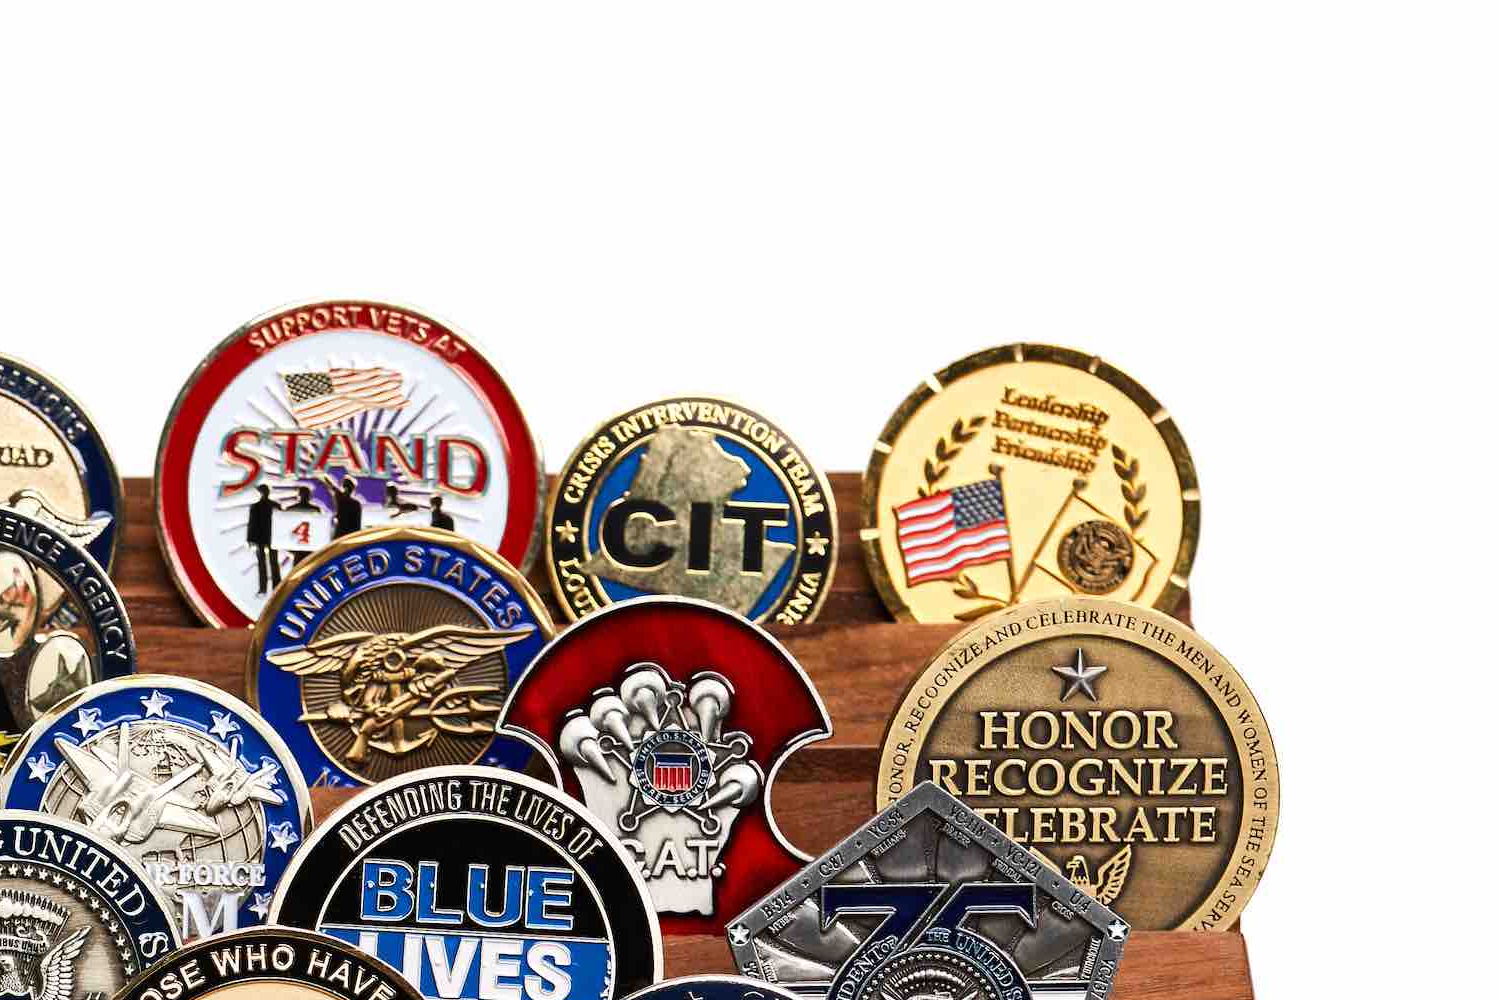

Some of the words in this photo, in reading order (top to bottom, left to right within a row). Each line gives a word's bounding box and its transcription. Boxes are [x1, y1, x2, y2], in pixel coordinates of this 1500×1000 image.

[248, 306, 363, 353] SUPPORT
[369, 306, 430, 343] VETS
[433, 332, 468, 361] AT
[1001, 386, 1109, 432] Leadership
[991, 410, 1108, 457] Partnership
[218, 426, 492, 500] STAND
[564, 435, 616, 504] CRISIS
[611, 401, 782, 454] INTERVENTION
[779, 446, 825, 517] TEAM
[991, 436, 1097, 476] Friendship
[602, 498, 791, 576] CIT
[67, 562, 128, 664] AGENCY
[279, 548, 392, 640] UNITED
[404, 545, 523, 629] STATES
[985, 622, 1023, 650] AND
[1026, 610, 1137, 630] CELEBRATE
[1141, 621, 1175, 646] THE
[1176, 640, 1214, 675] MEN
[904, 642, 984, 732] RECOGNIZE
[1209, 669, 1241, 708] AND
[979, 710, 1178, 750] HONOR
[1236, 708, 1267, 781] WOMEN
[929, 757, 1229, 797] RECOGNIZE
[1254, 787, 1267, 811] OF
[338, 779, 461, 853] DEFENDING
[469, 780, 509, 814] THE
[514, 790, 576, 840] LIVES
[569, 828, 604, 861] OF
[976, 806, 1217, 843] ELEBRATE
[1245, 816, 1266, 852] THE
[13, 826, 148, 918] UNITED
[178, 863, 267, 887] FORCE
[359, 858, 575, 931] BLUE
[1194, 890, 1236, 932] SERV
[211, 943, 297, 979] WHO
[954, 932, 1015, 988] UNITED
